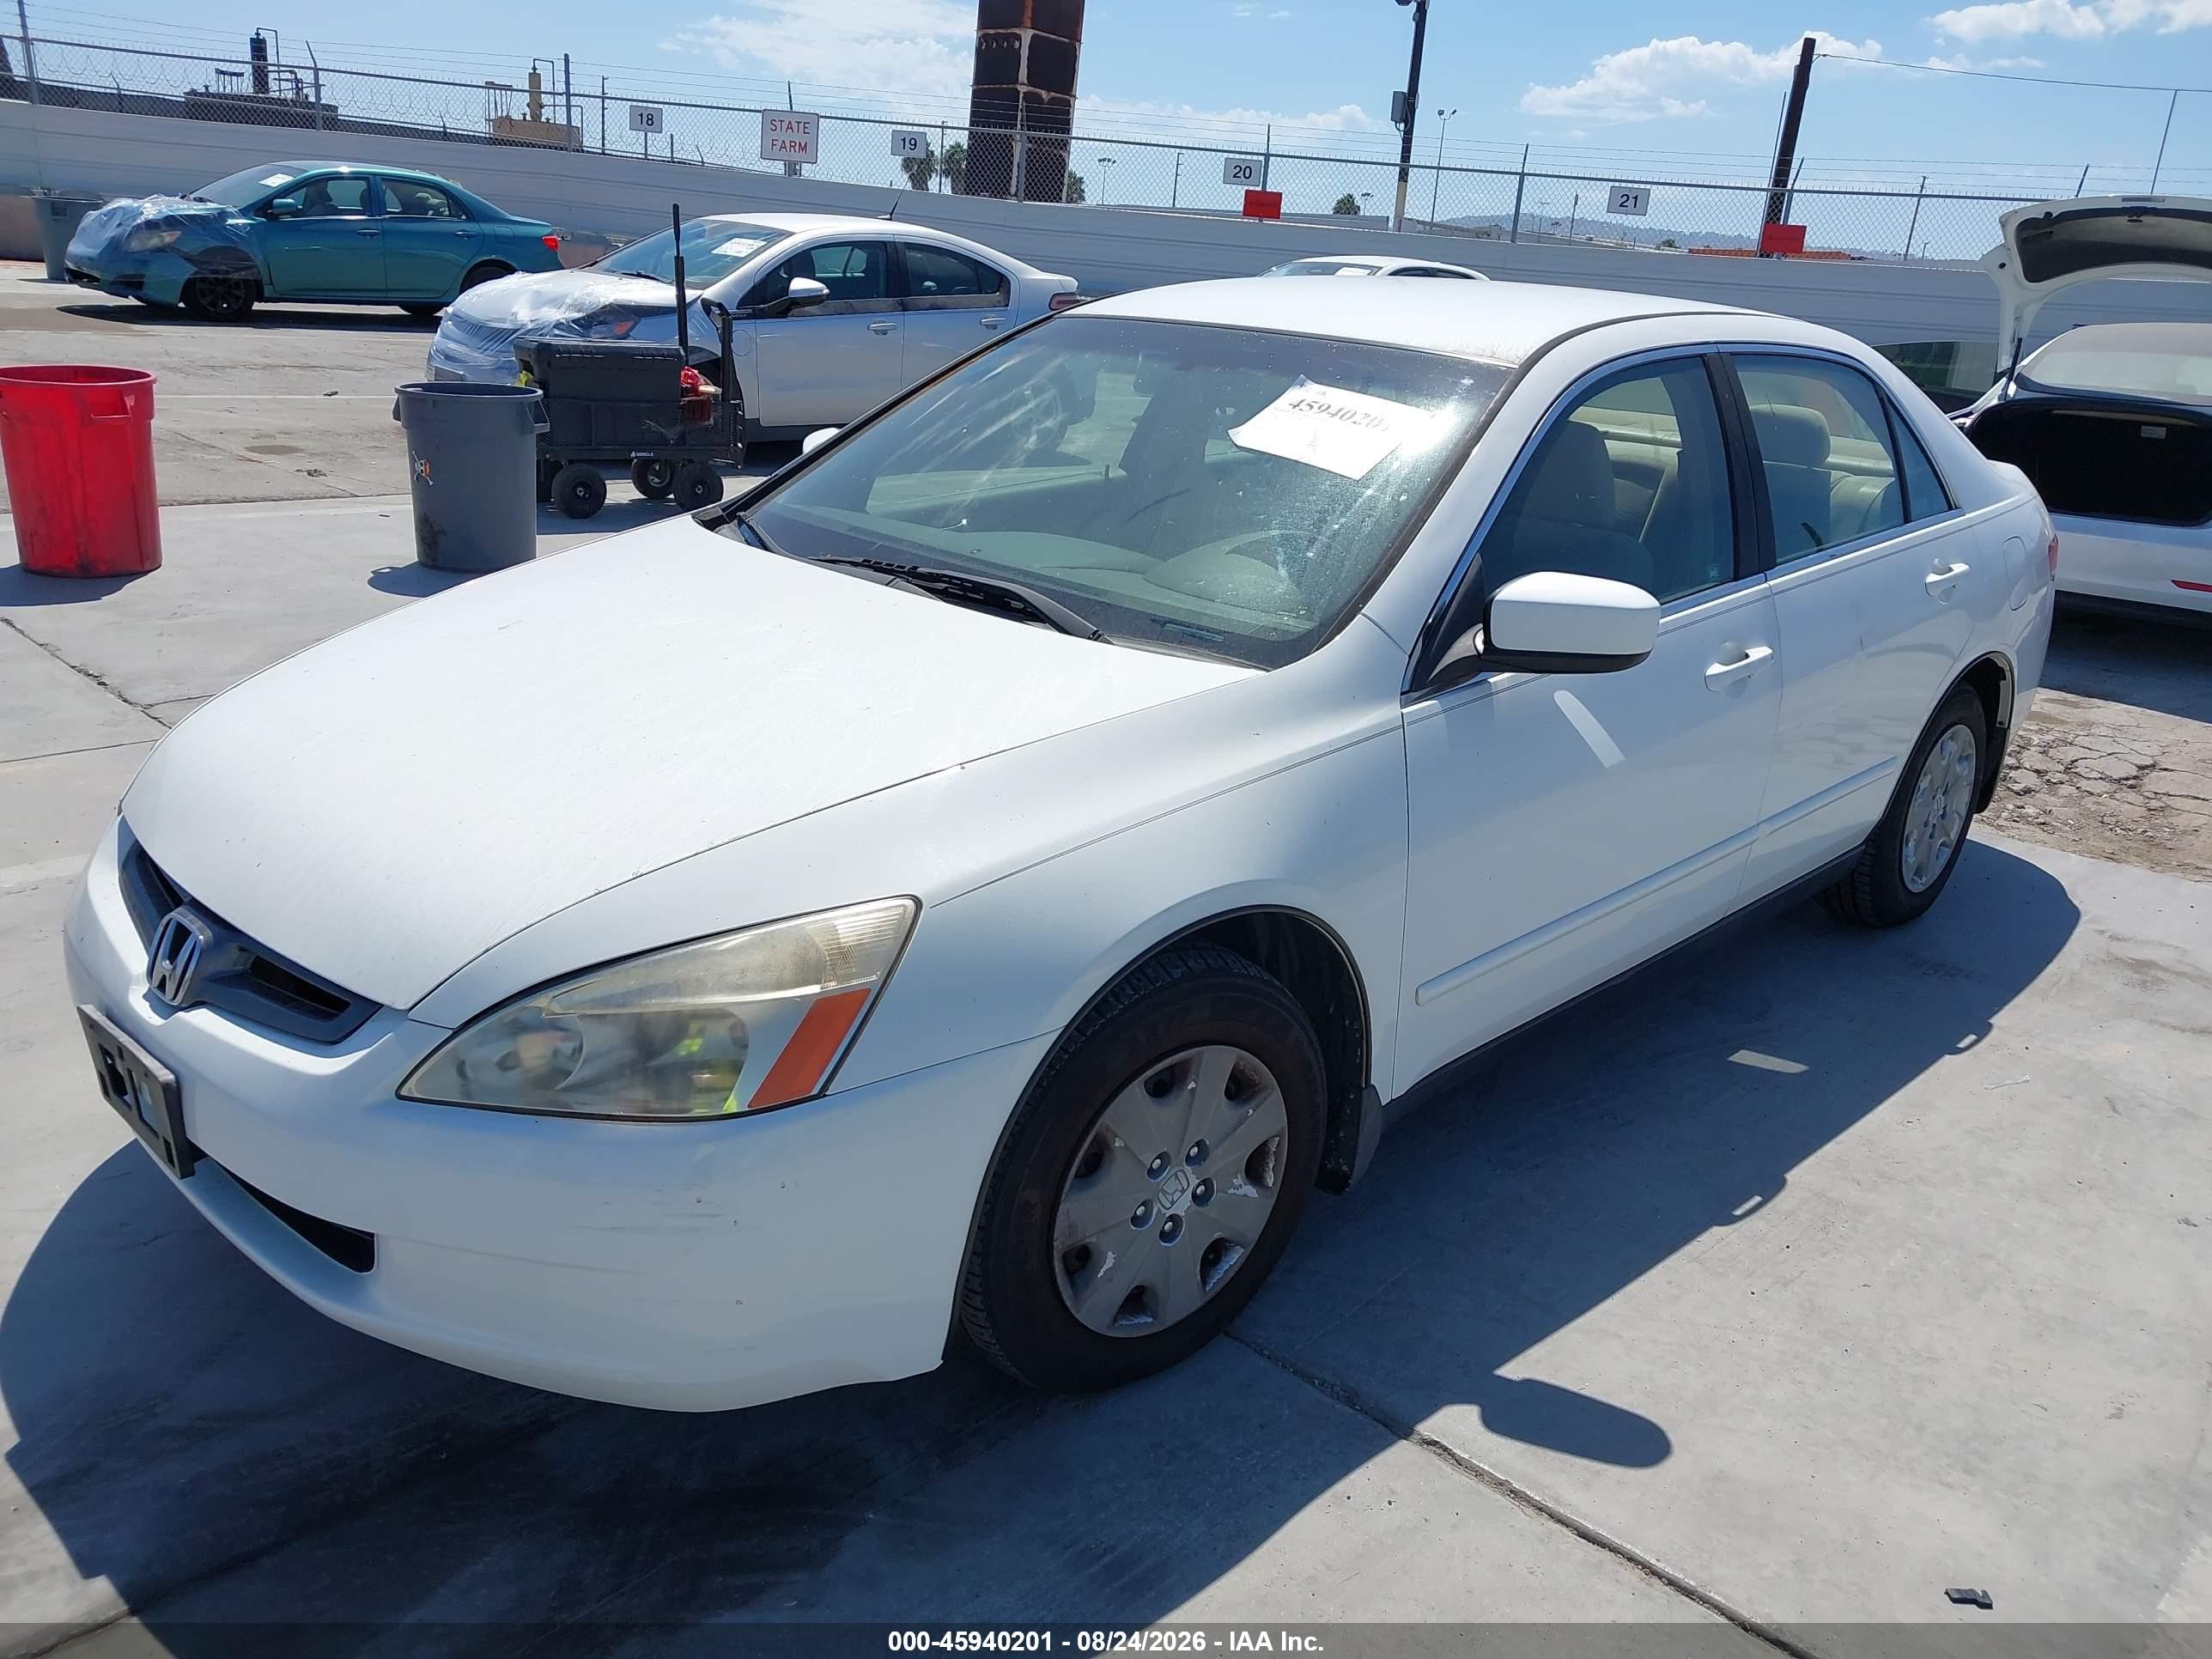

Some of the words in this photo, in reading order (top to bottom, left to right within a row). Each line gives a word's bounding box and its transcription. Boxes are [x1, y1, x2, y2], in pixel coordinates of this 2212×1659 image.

[638, 112, 654, 126] 18
[769, 118, 811, 135] STATE
[771, 138, 807, 155] FARM
[900, 137, 917, 151] 19
[1232, 164, 1253, 179] 20
[1619, 193, 1638, 209] 21
